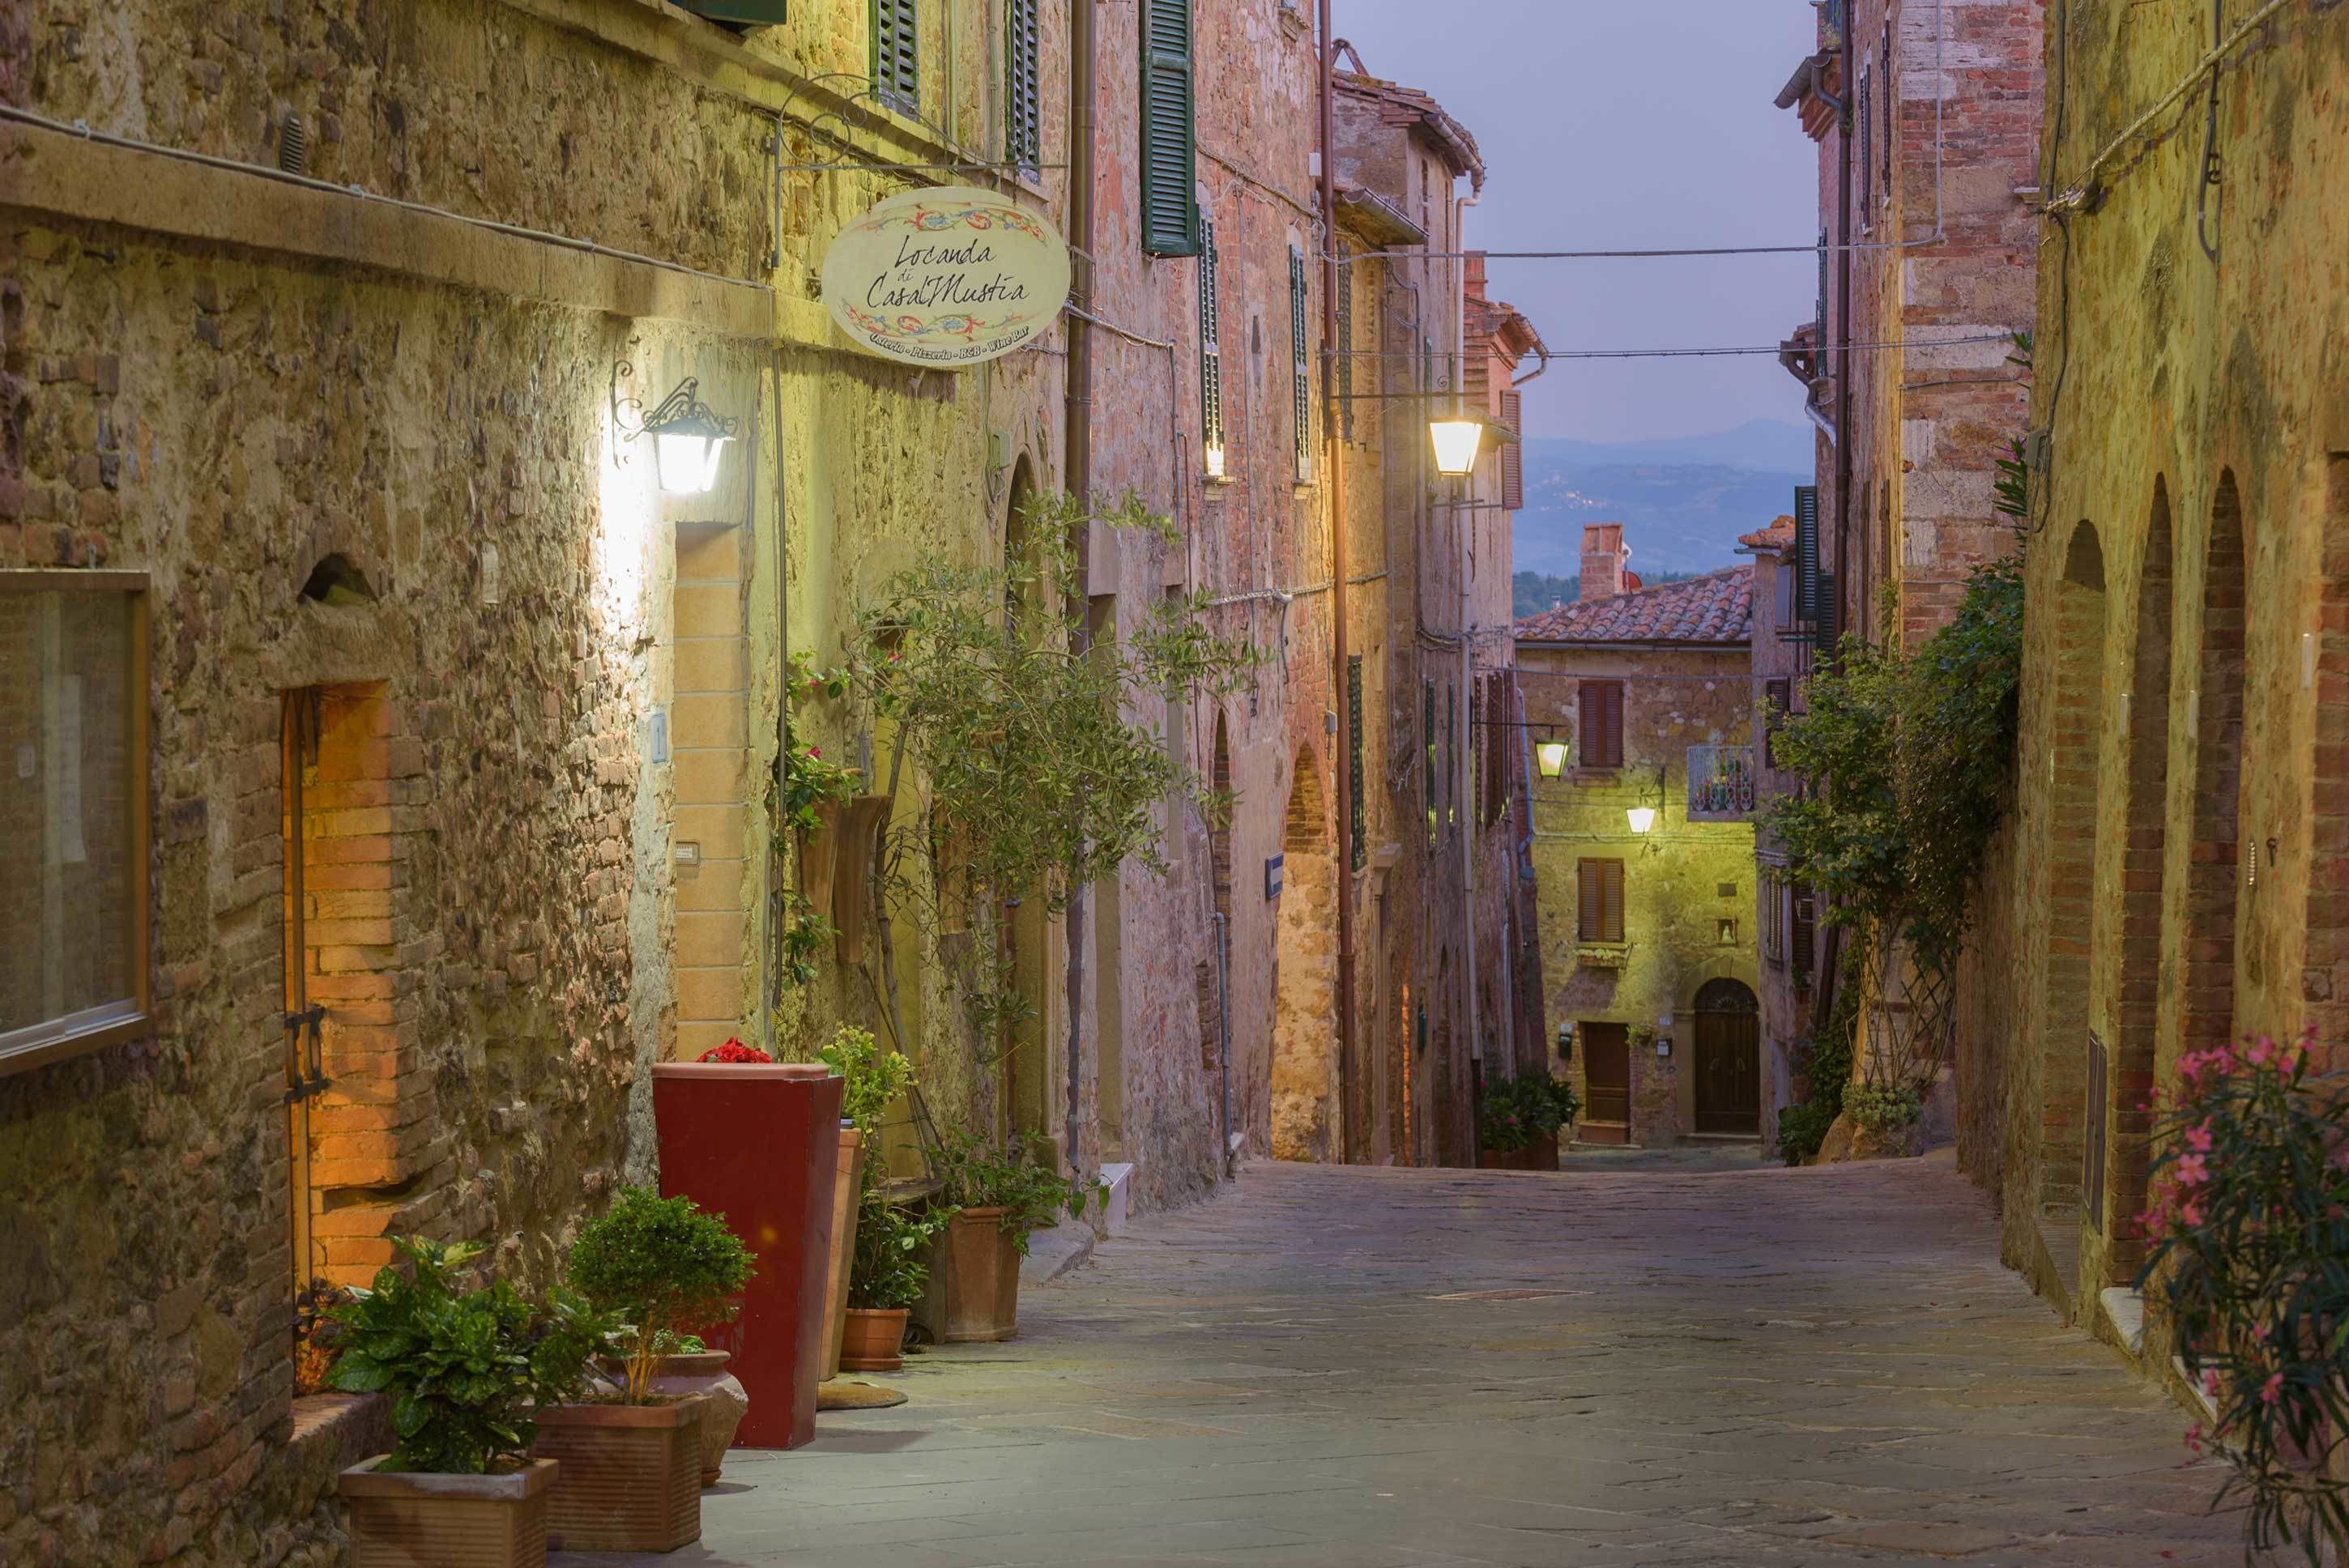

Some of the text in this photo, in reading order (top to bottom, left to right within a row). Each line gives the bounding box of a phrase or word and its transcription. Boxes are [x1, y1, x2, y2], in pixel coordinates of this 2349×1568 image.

[895, 235, 997, 268] Locanda
[897, 268, 914, 282] di
[869, 333, 905, 354] Osteria
[910, 347, 953, 360] Pizzeria
[959, 345, 981, 360] B&B
[987, 335, 1013, 352] Wine
[1011, 326, 1030, 343] Bar
